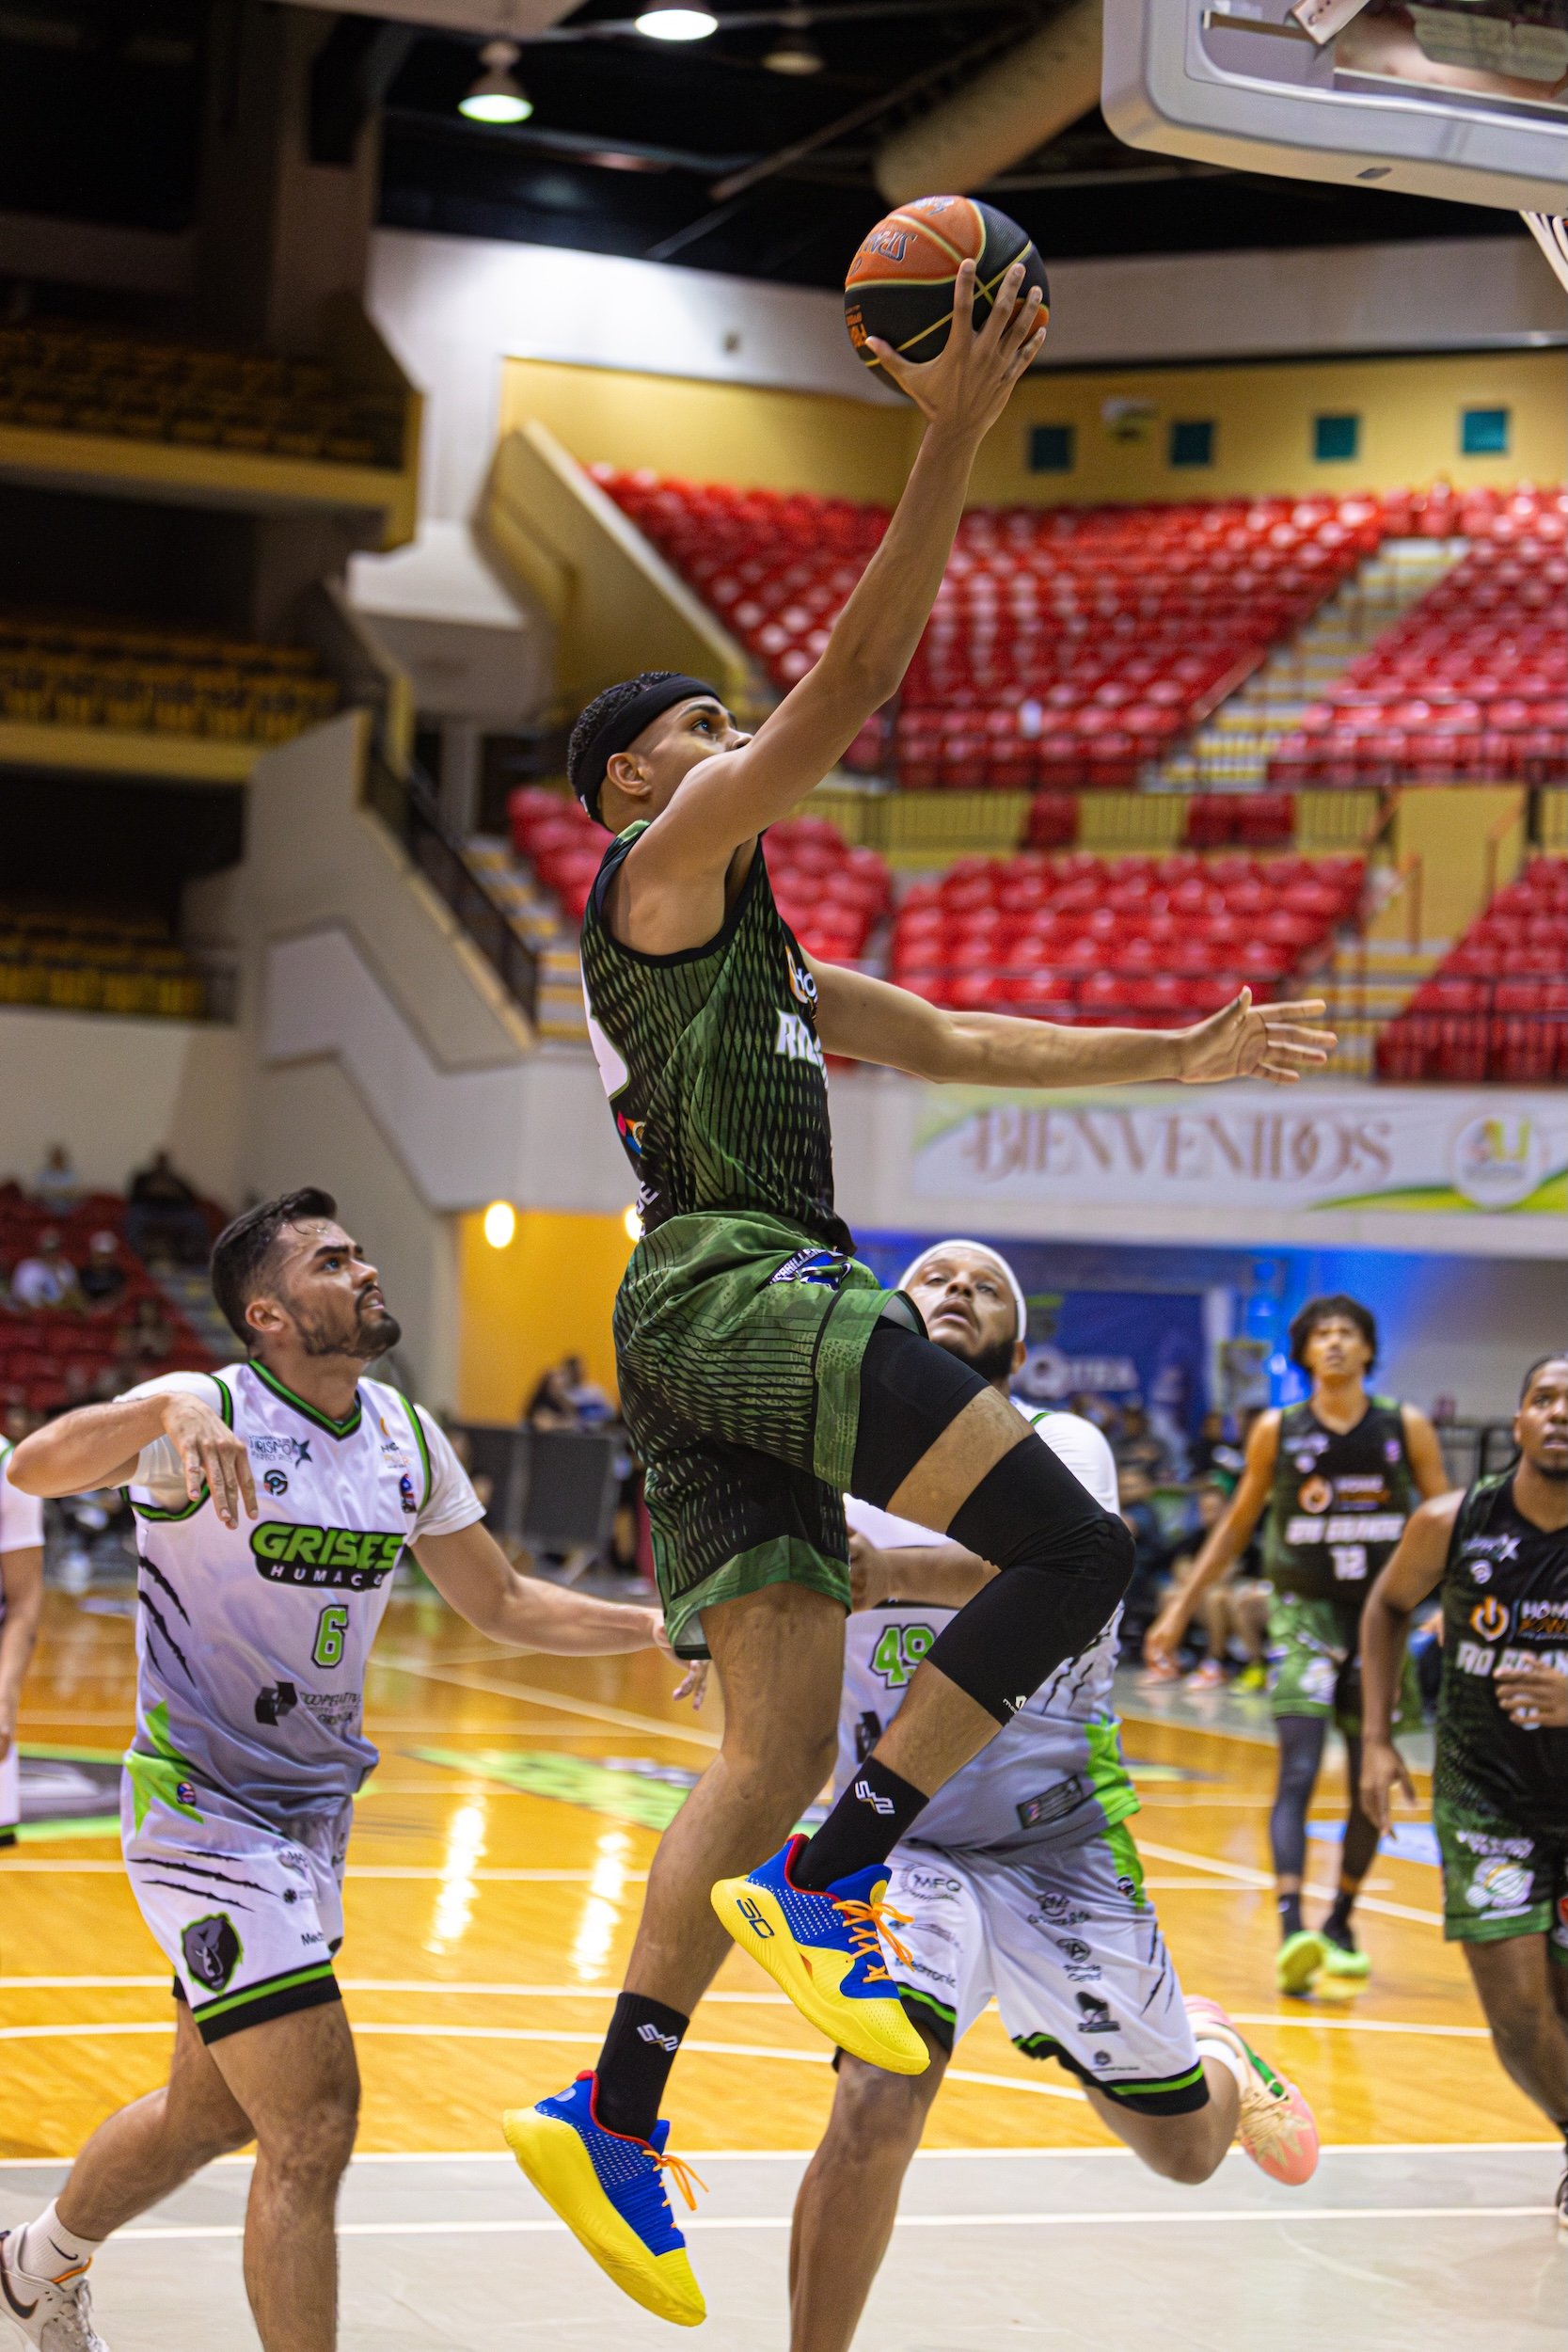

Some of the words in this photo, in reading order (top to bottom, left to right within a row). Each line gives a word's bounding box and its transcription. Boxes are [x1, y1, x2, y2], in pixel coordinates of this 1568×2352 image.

[251, 1522, 404, 1570] GRISES
[310, 1604, 349, 1668] 6
[870, 1623, 937, 1690] 49
[912, 1873, 962, 1893] MFQ
